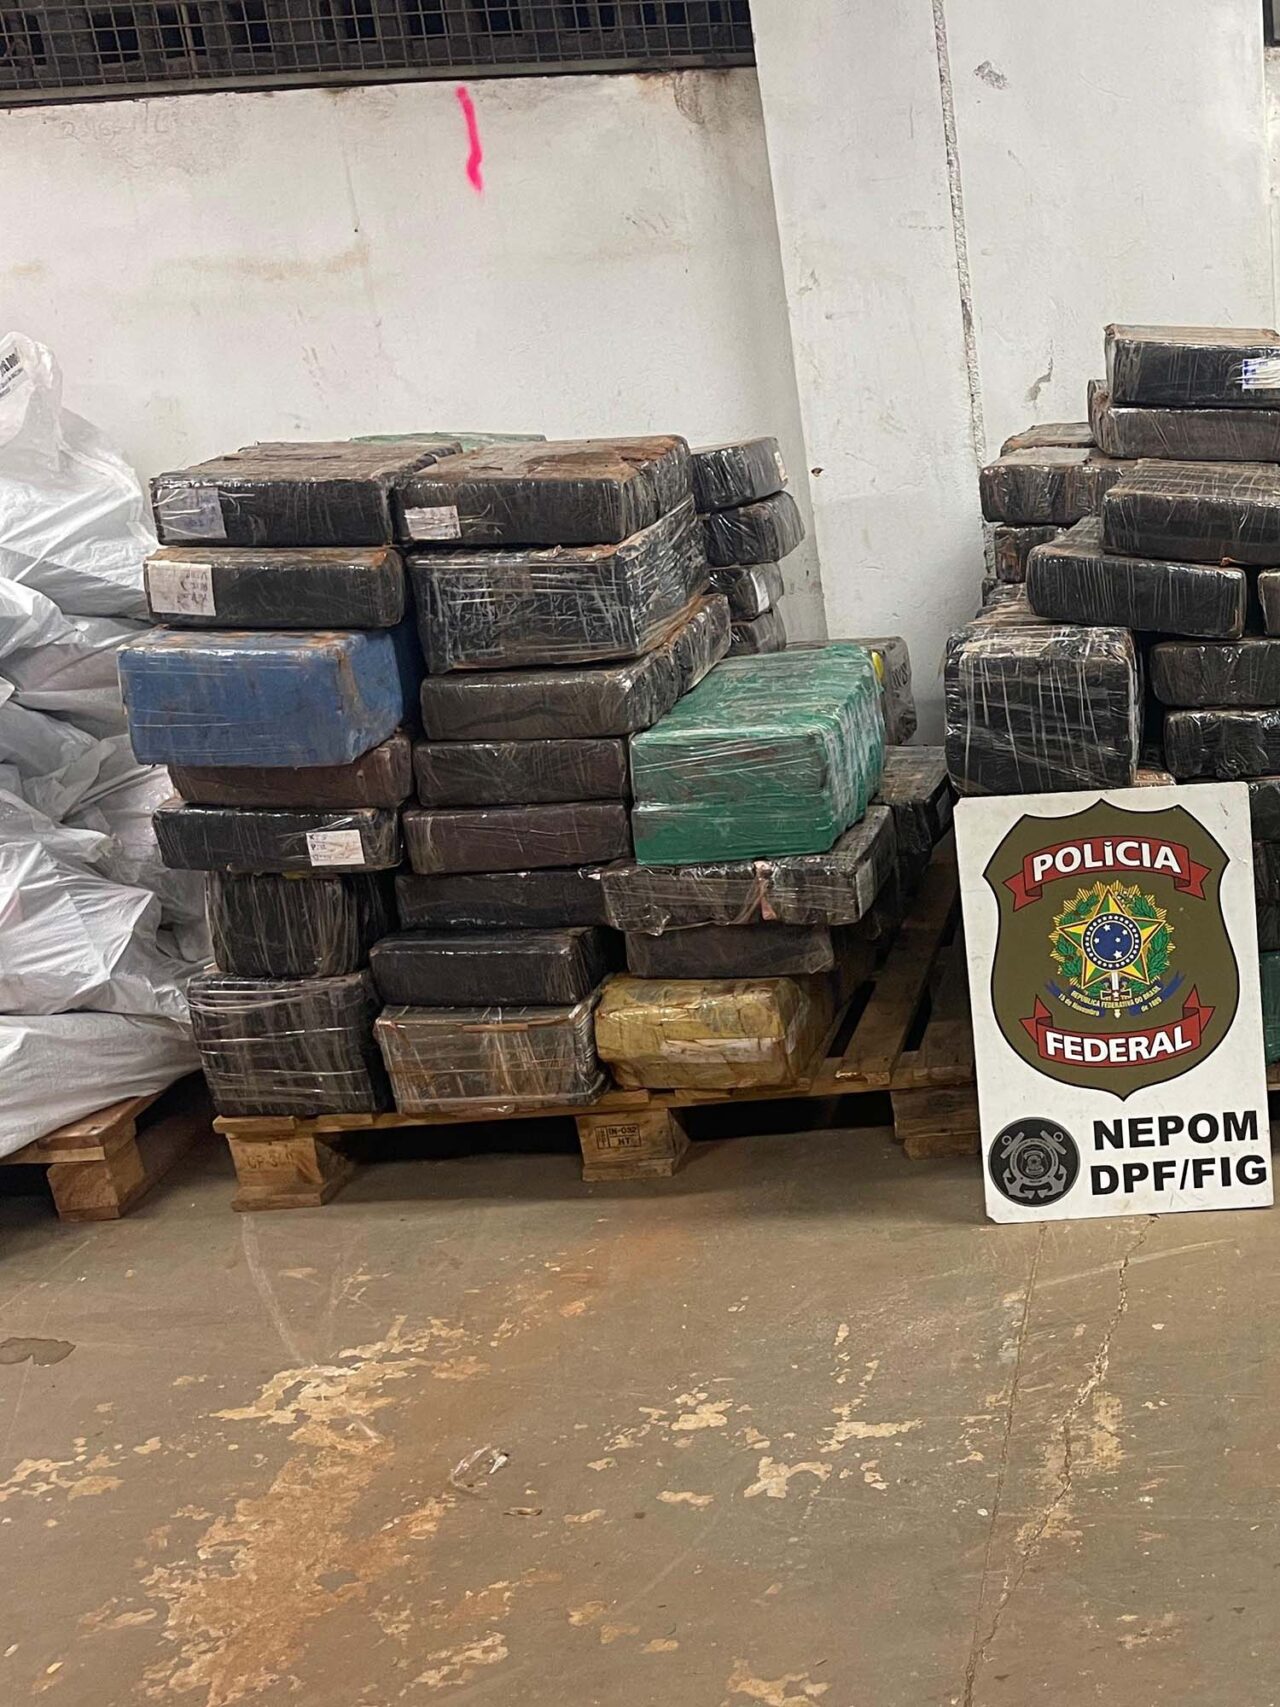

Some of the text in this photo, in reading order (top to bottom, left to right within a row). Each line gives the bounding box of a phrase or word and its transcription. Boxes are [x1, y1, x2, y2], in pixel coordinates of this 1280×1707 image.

[1045, 1025, 1192, 1063] FEDERAL
[1093, 1110, 1259, 1151] NEPOM
[1090, 1154, 1267, 1196] DPF/FIG
